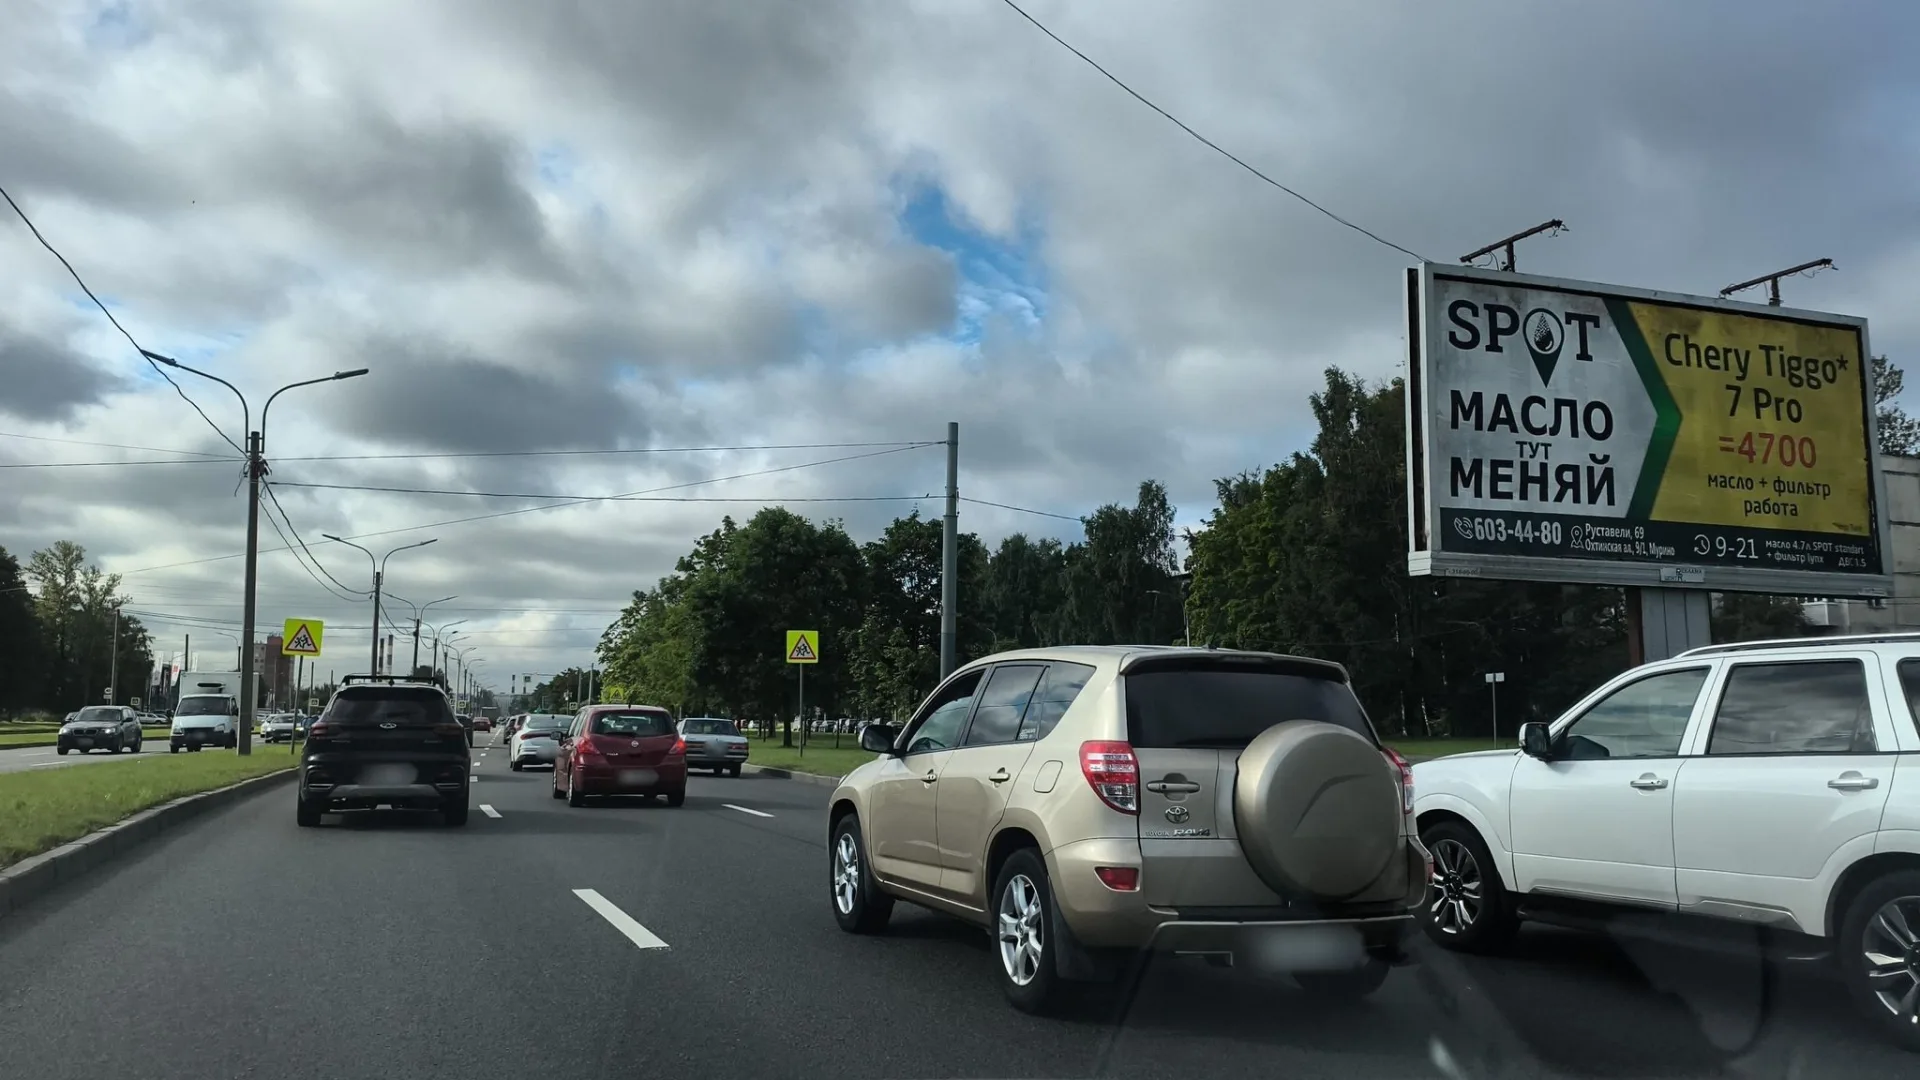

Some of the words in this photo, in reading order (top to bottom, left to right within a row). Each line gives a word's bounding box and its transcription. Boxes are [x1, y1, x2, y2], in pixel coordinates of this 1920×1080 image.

[1447, 299, 1600, 388] SPOT
[1664, 333, 1750, 381] Chery
[1450, 389, 1613, 441] МАСЛО
[1725, 384, 1742, 417] 7
[1753, 388, 1802, 423] Pro
[1515, 440, 1552, 460] ТУТ
[1718, 431, 1817, 469] =4700
[1450, 453, 1616, 506] МЕНЯЙ
[1707, 473, 1754, 491] масло
[1773, 476, 1831, 499] фильтр
[1744, 499, 1798, 517] работа
[1474, 517, 1562, 545] 603-44-80
[1585, 523, 1633, 540] Руставели,
[1634, 526, 1645, 539] 69
[1715, 536, 1759, 559] 9-21
[1765, 540, 1791, 549] масло
[1812, 541, 1833, 552] SPOT
